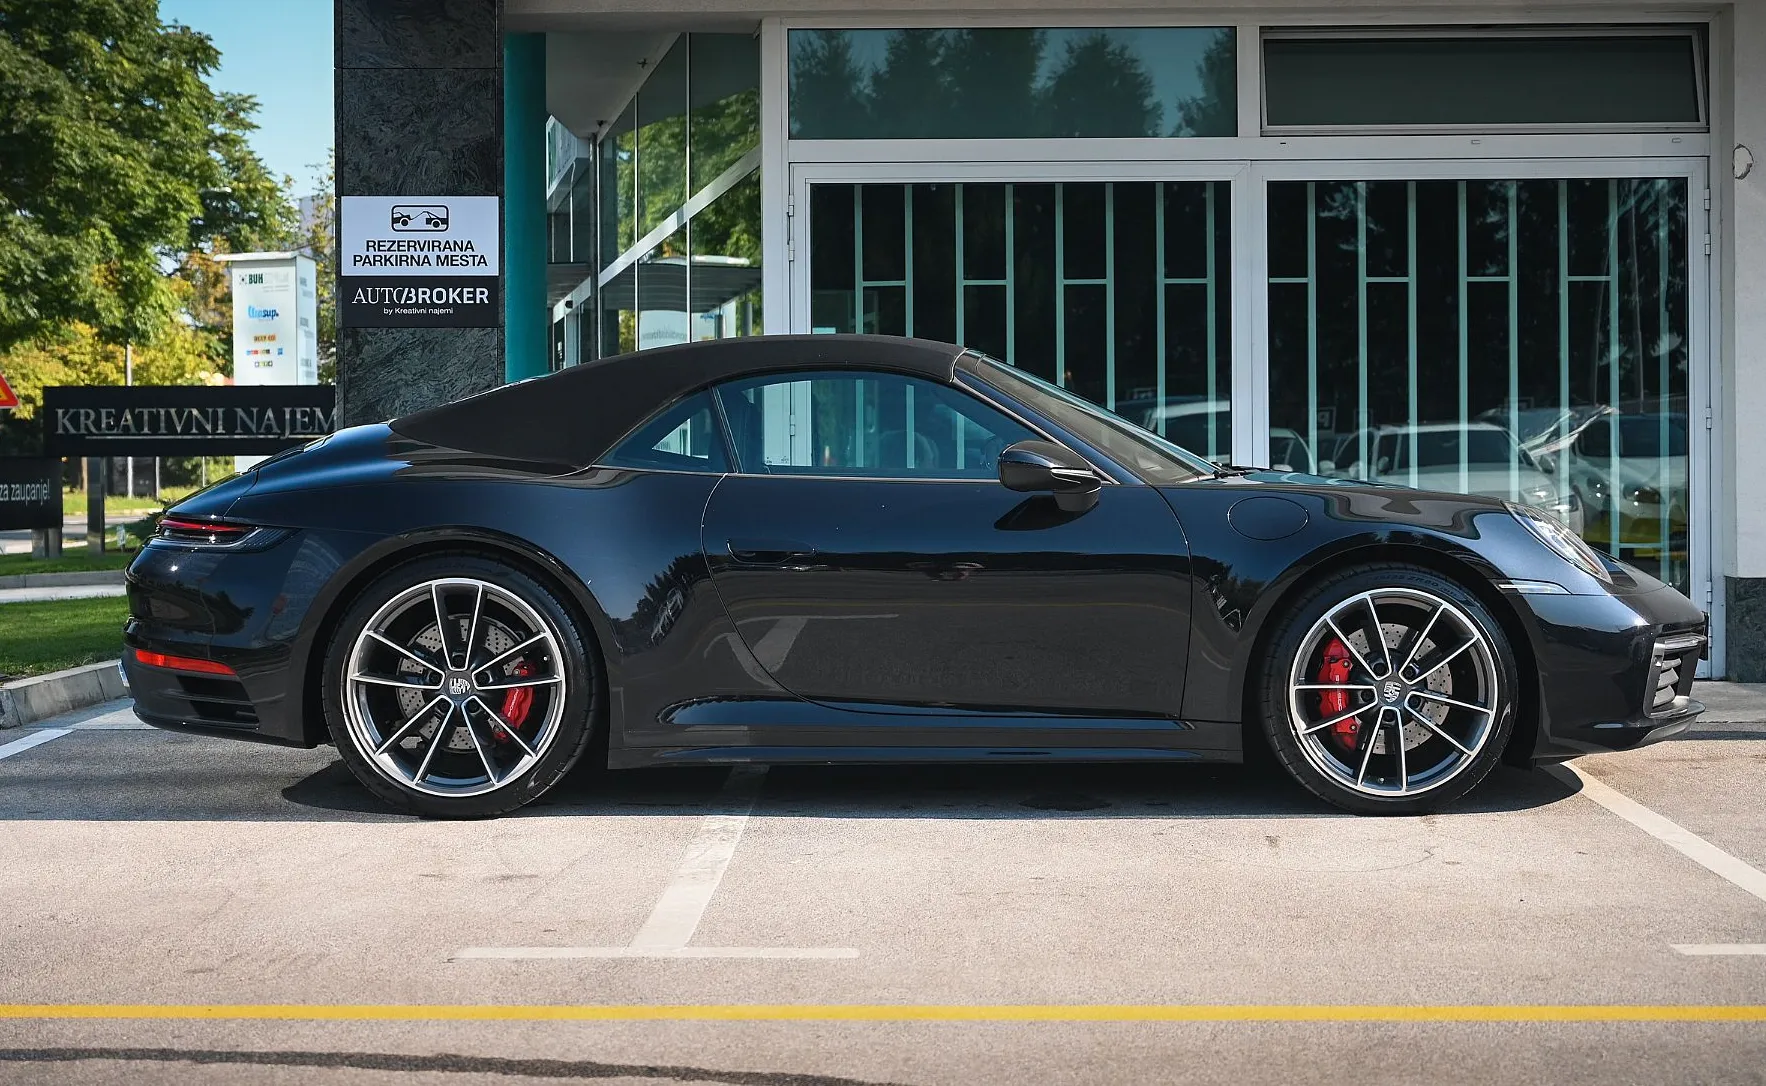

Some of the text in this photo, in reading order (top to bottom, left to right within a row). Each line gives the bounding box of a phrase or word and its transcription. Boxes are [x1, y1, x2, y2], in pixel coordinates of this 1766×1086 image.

[366, 240, 475, 252] REZERVIRANA
[353, 254, 488, 267] PARKIRNA MESTA
[383, 307, 393, 315] by
[428, 307, 454, 315] najemi
[55, 407, 226, 434] KREATIVNI
[11, 479, 51, 506] zaupanje!
